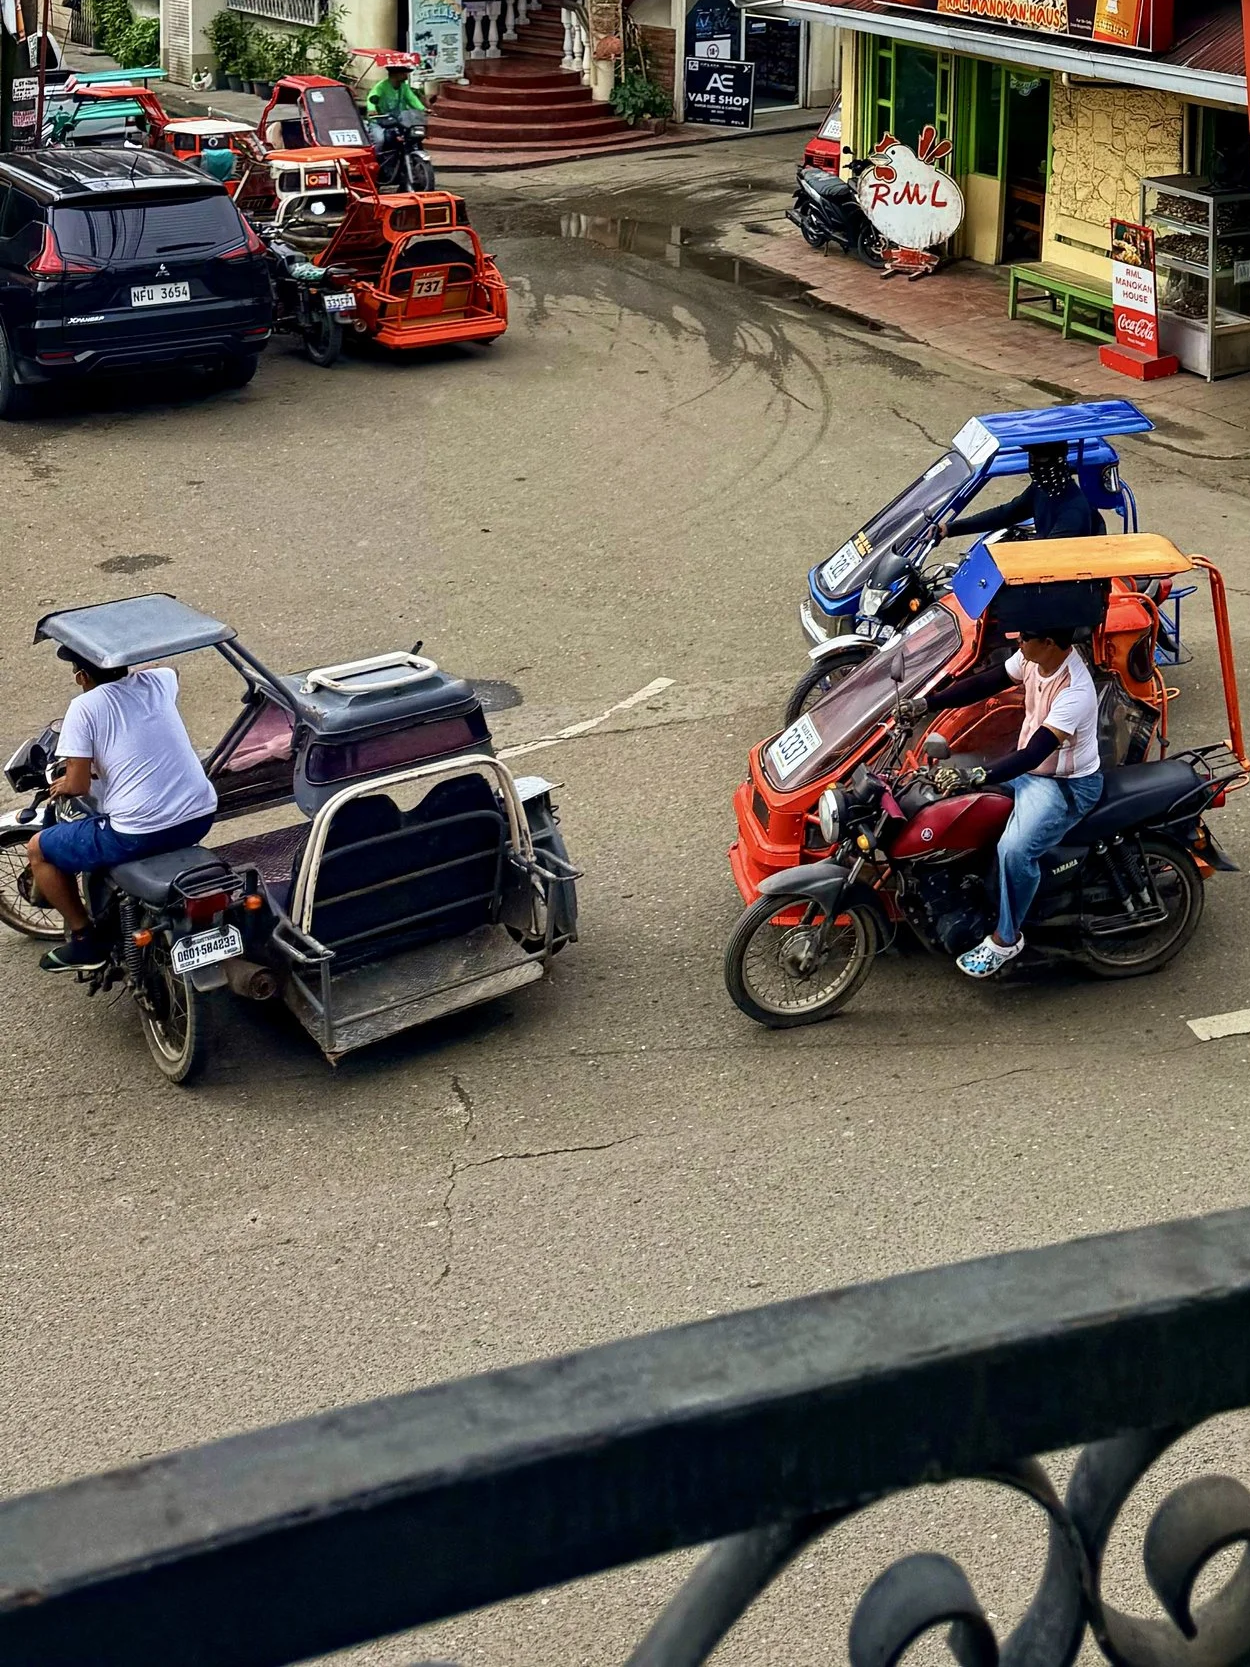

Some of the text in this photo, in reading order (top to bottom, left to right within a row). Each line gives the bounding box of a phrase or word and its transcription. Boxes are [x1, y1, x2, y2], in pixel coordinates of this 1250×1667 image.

[688, 92, 749, 106] VAPE SHOP
[869, 180, 948, 210] RML
[1125, 268, 1142, 280] RML
[416, 280, 440, 294] 737
[1115, 276, 1153, 295] MANOKAN
[133, 286, 188, 302] NFU 3654
[1122, 290, 1148, 304] HOUSE
[1117, 313, 1155, 340] Coca-Cola
[778, 727, 808, 766] 3337
